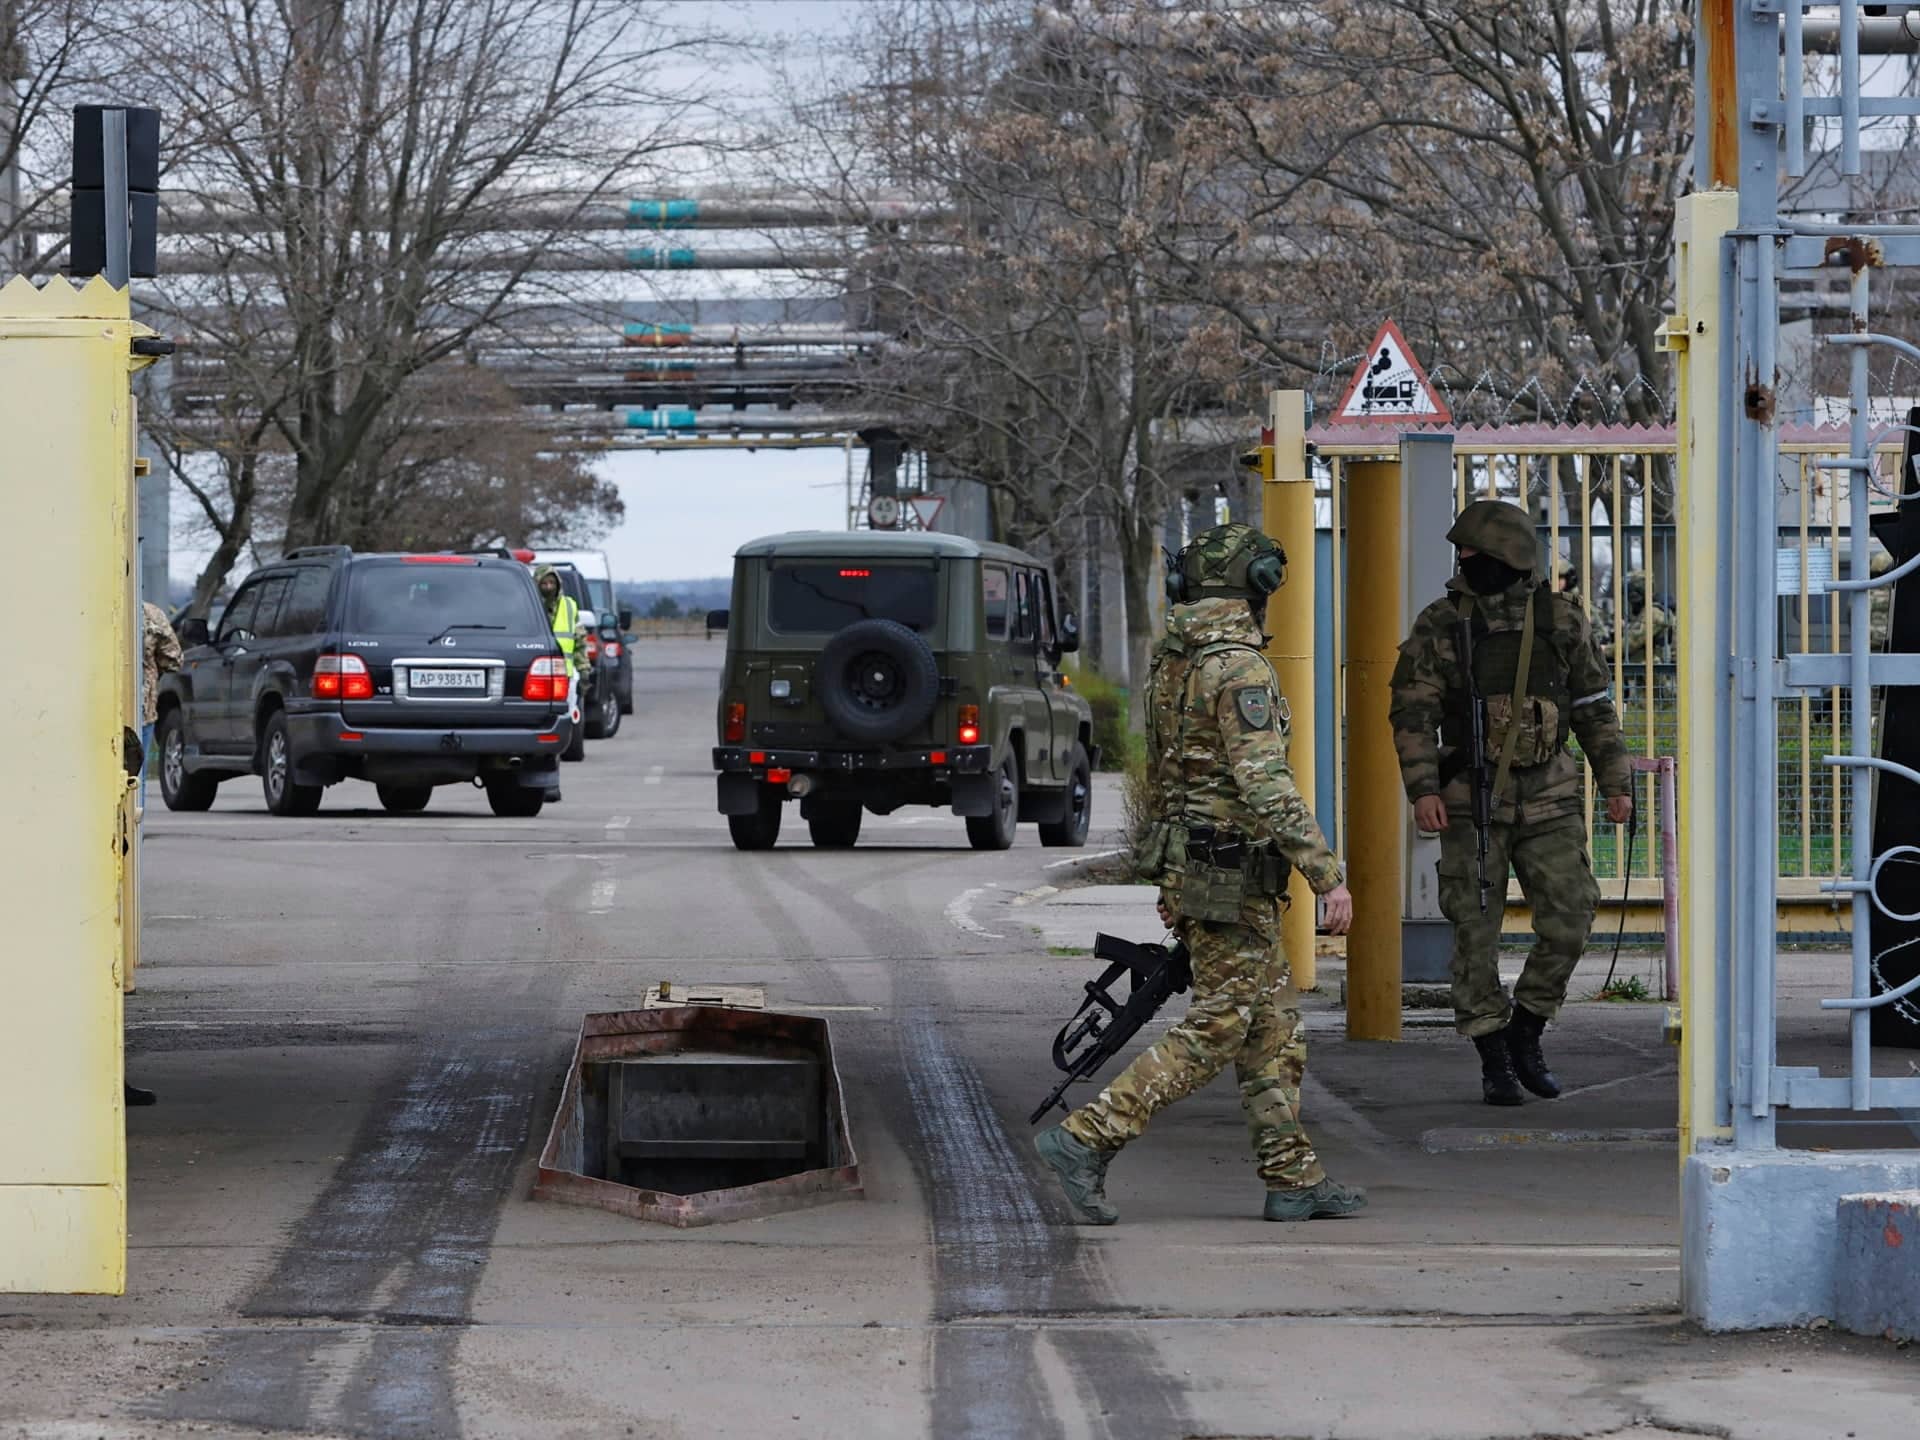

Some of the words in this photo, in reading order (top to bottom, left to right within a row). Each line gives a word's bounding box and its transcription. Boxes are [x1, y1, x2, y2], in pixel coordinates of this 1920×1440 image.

[419, 673, 435, 686] AP
[437, 673, 463, 686] 9383
[465, 673, 481, 686] AT
